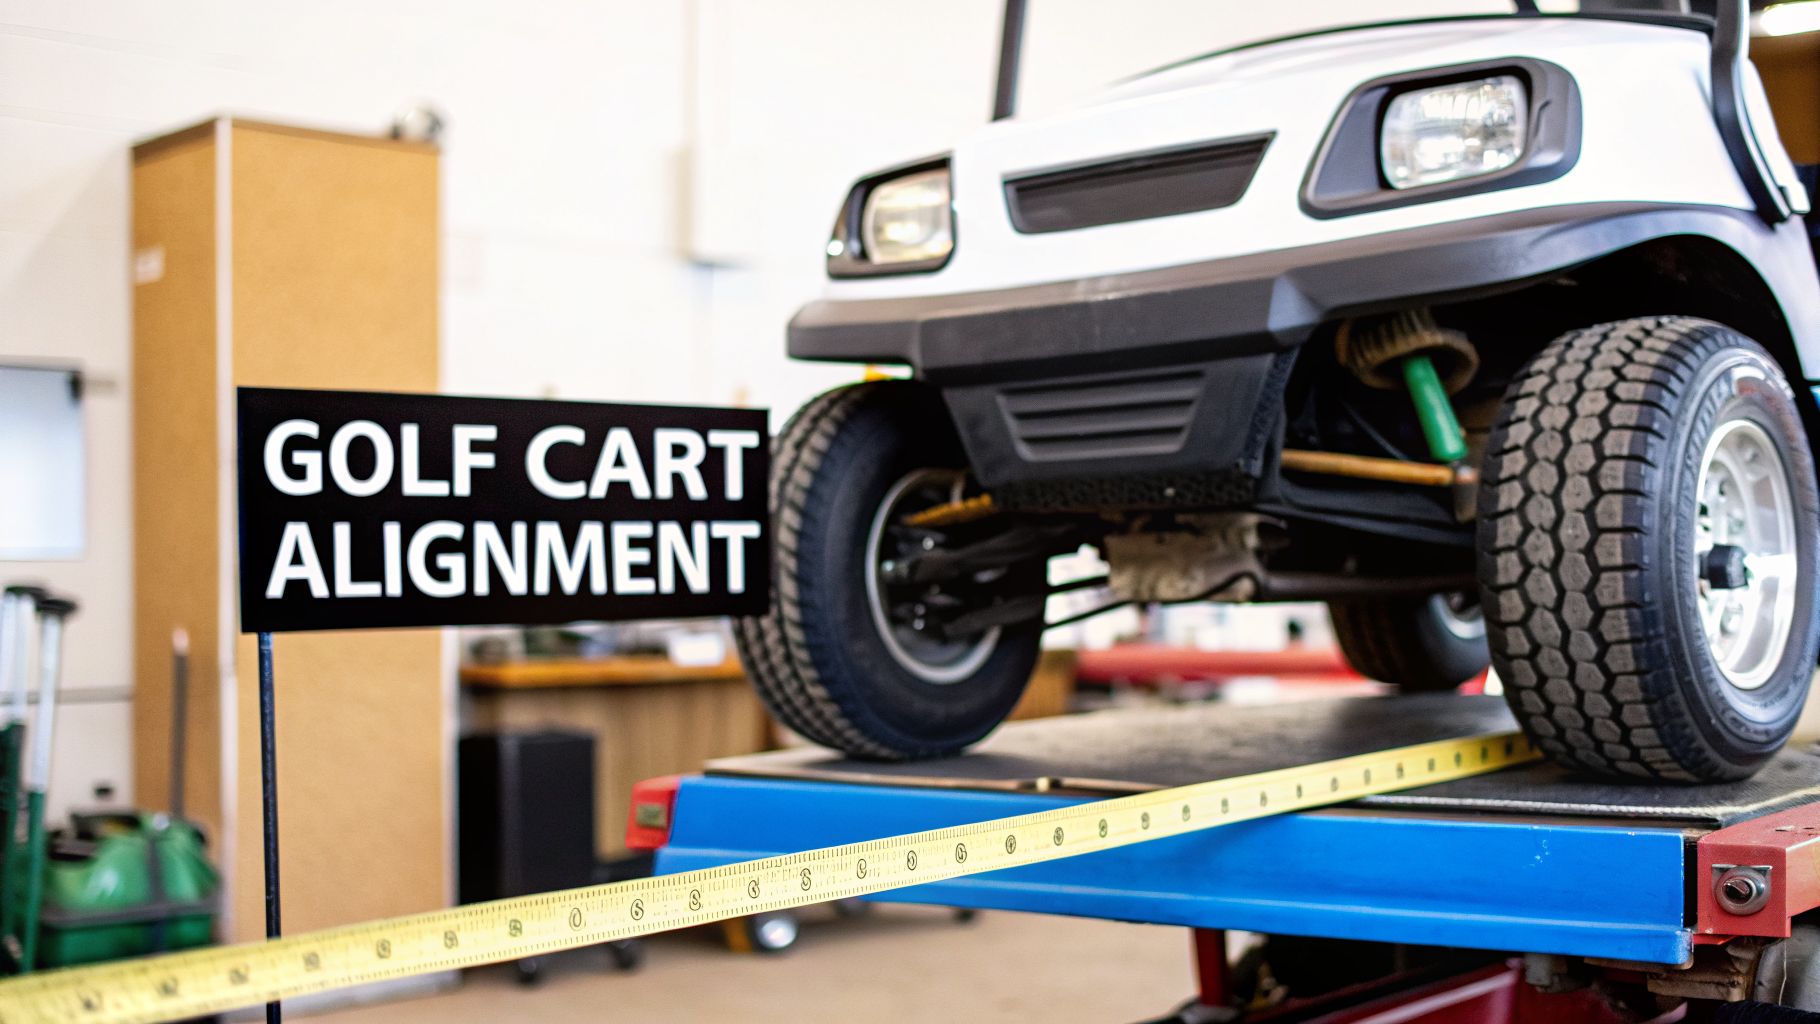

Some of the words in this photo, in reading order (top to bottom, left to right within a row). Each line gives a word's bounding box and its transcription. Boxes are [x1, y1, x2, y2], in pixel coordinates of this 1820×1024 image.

[264, 419, 498, 497] GOLF
[525, 425, 760, 501] CART
[265, 520, 762, 599] ALIGNMENT
